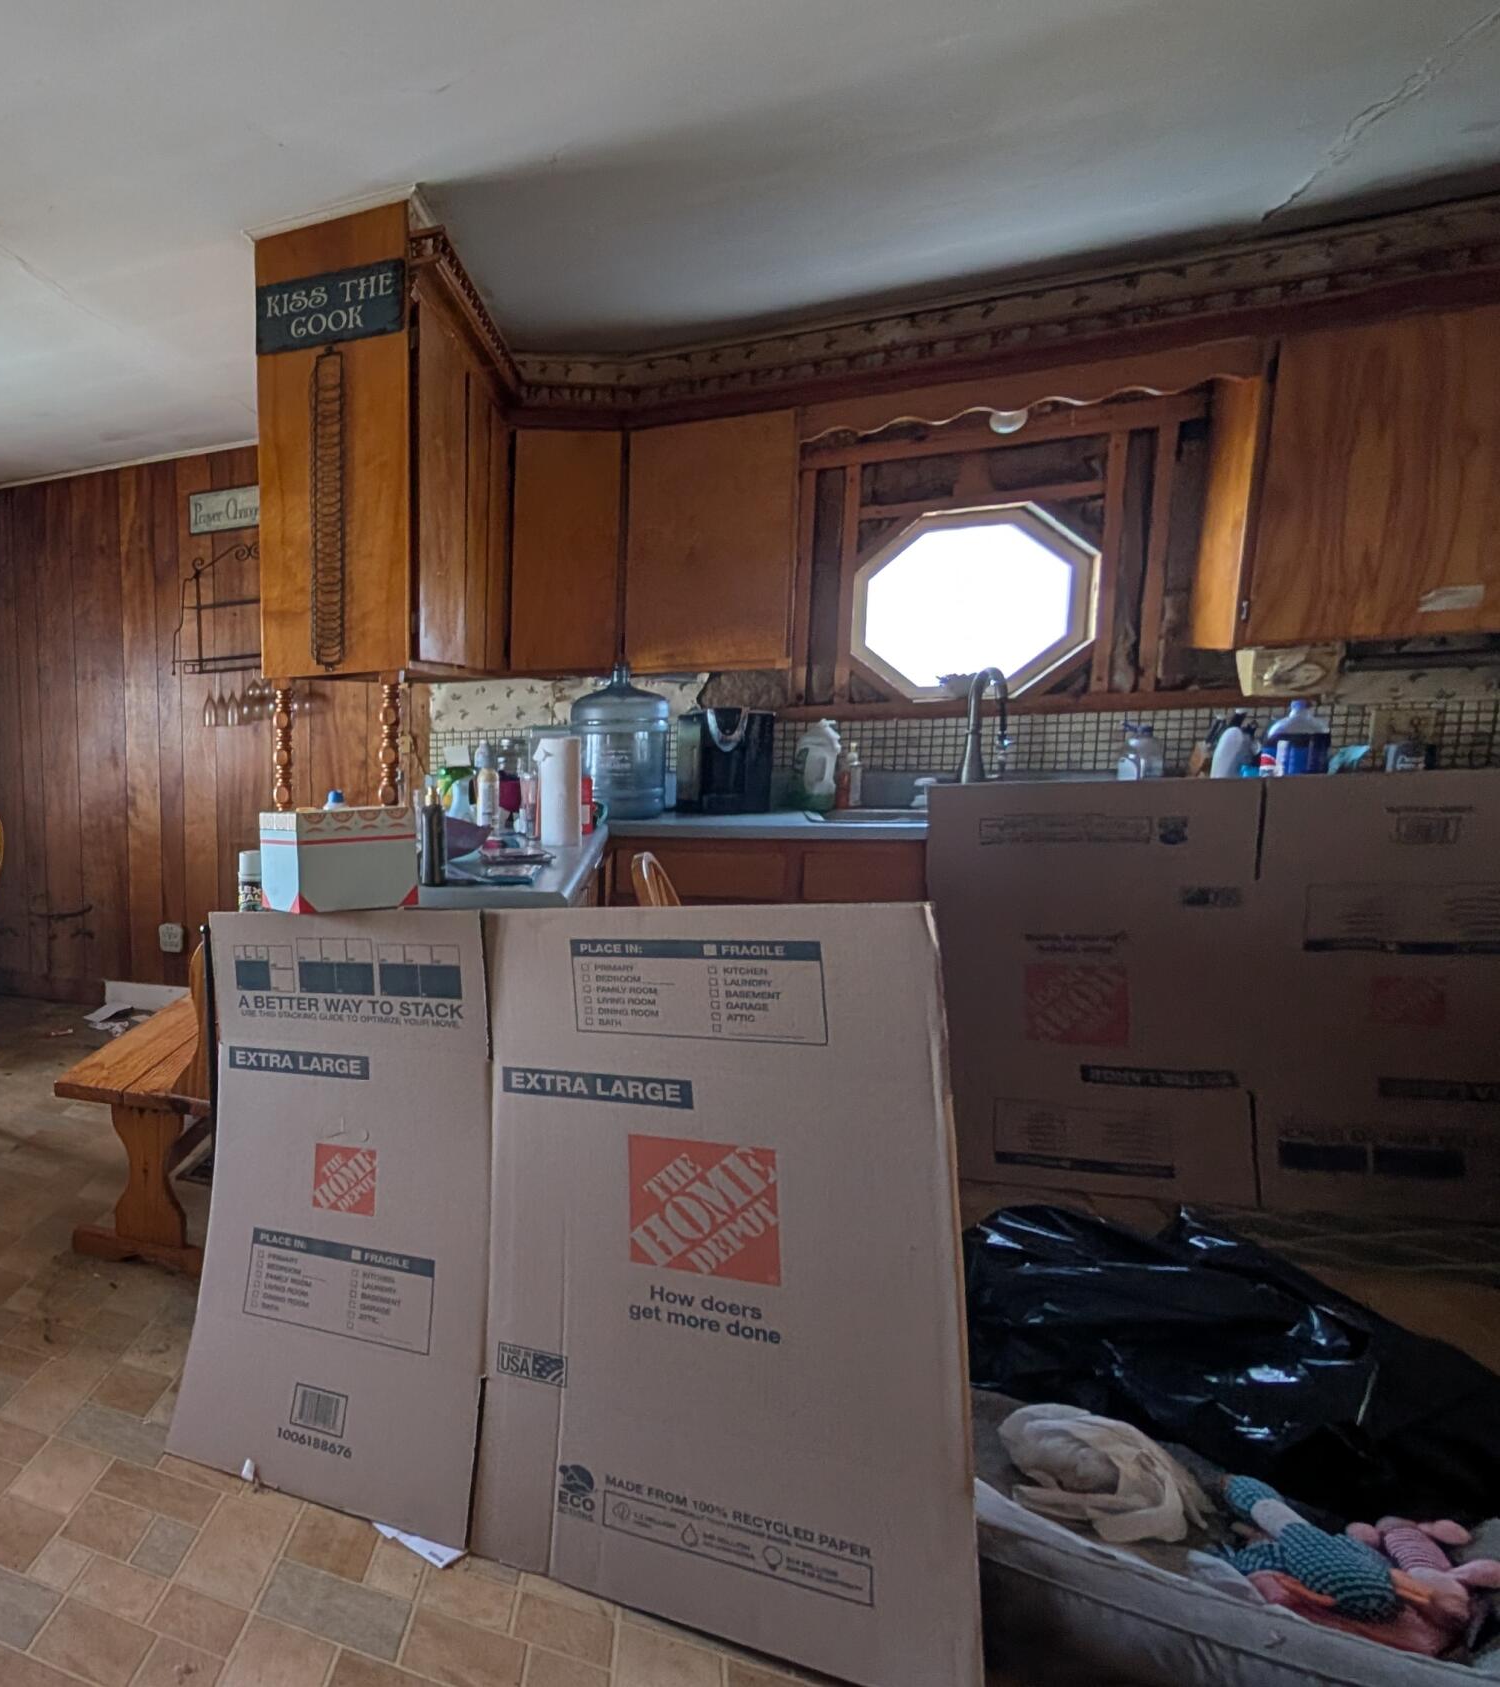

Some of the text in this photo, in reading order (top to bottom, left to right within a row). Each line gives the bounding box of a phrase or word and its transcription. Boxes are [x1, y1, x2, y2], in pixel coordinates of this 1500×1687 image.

[266, 272, 393, 318] KISS THE
[290, 305, 364, 339] COOK
[580, 943, 643, 954] PLACE IN:
[721, 945, 785, 956] FRAGILE
[596, 975, 641, 983] BEDROOM
[723, 967, 768, 975] KITCHEN
[596, 986, 658, 995] FAMILY ROOM
[724, 979, 772, 988] LAUNDRY
[725, 990, 781, 1000] BASEMENT
[239, 995, 463, 1020] A BETTER WAY TO STACK
[628, 998, 656, 1006] ROOM
[631, 1009, 659, 1017] ROOM
[726, 1001, 769, 1012] GARAGE
[259, 1010, 276, 1018] THIS
[319, 1012, 344, 1022] GUIDE
[346, 1014, 358, 1023] TO
[727, 1014, 755, 1023] ATTIC
[235, 1050, 362, 1075] EXTRA LARGE
[511, 1072, 681, 1102] EXTRA LARGE
[322, 1152, 344, 1176] THE
[313, 1150, 376, 1209] HOME
[642, 1153, 703, 1201] THE
[337, 1175, 376, 1210] DEPOT
[630, 1146, 777, 1266] HOME
[260, 1233, 292, 1247] PLACE
[687, 1197, 780, 1275] DEPOT
[363, 1252, 410, 1269] FRAGILE
[650, 1285, 763, 1320] How doers
[629, 1304, 781, 1344] get more done
[501, 1353, 530, 1377] USA
[277, 1427, 352, 1459] 1006188676
[558, 1490, 596, 1511] ECO
[605, 1474, 644, 1496] MADE
[647, 1486, 688, 1507] FROM
[692, 1499, 728, 1519] 100%
[732, 1511, 815, 1543] RECYCLED
[819, 1535, 872, 1559] PAPER
